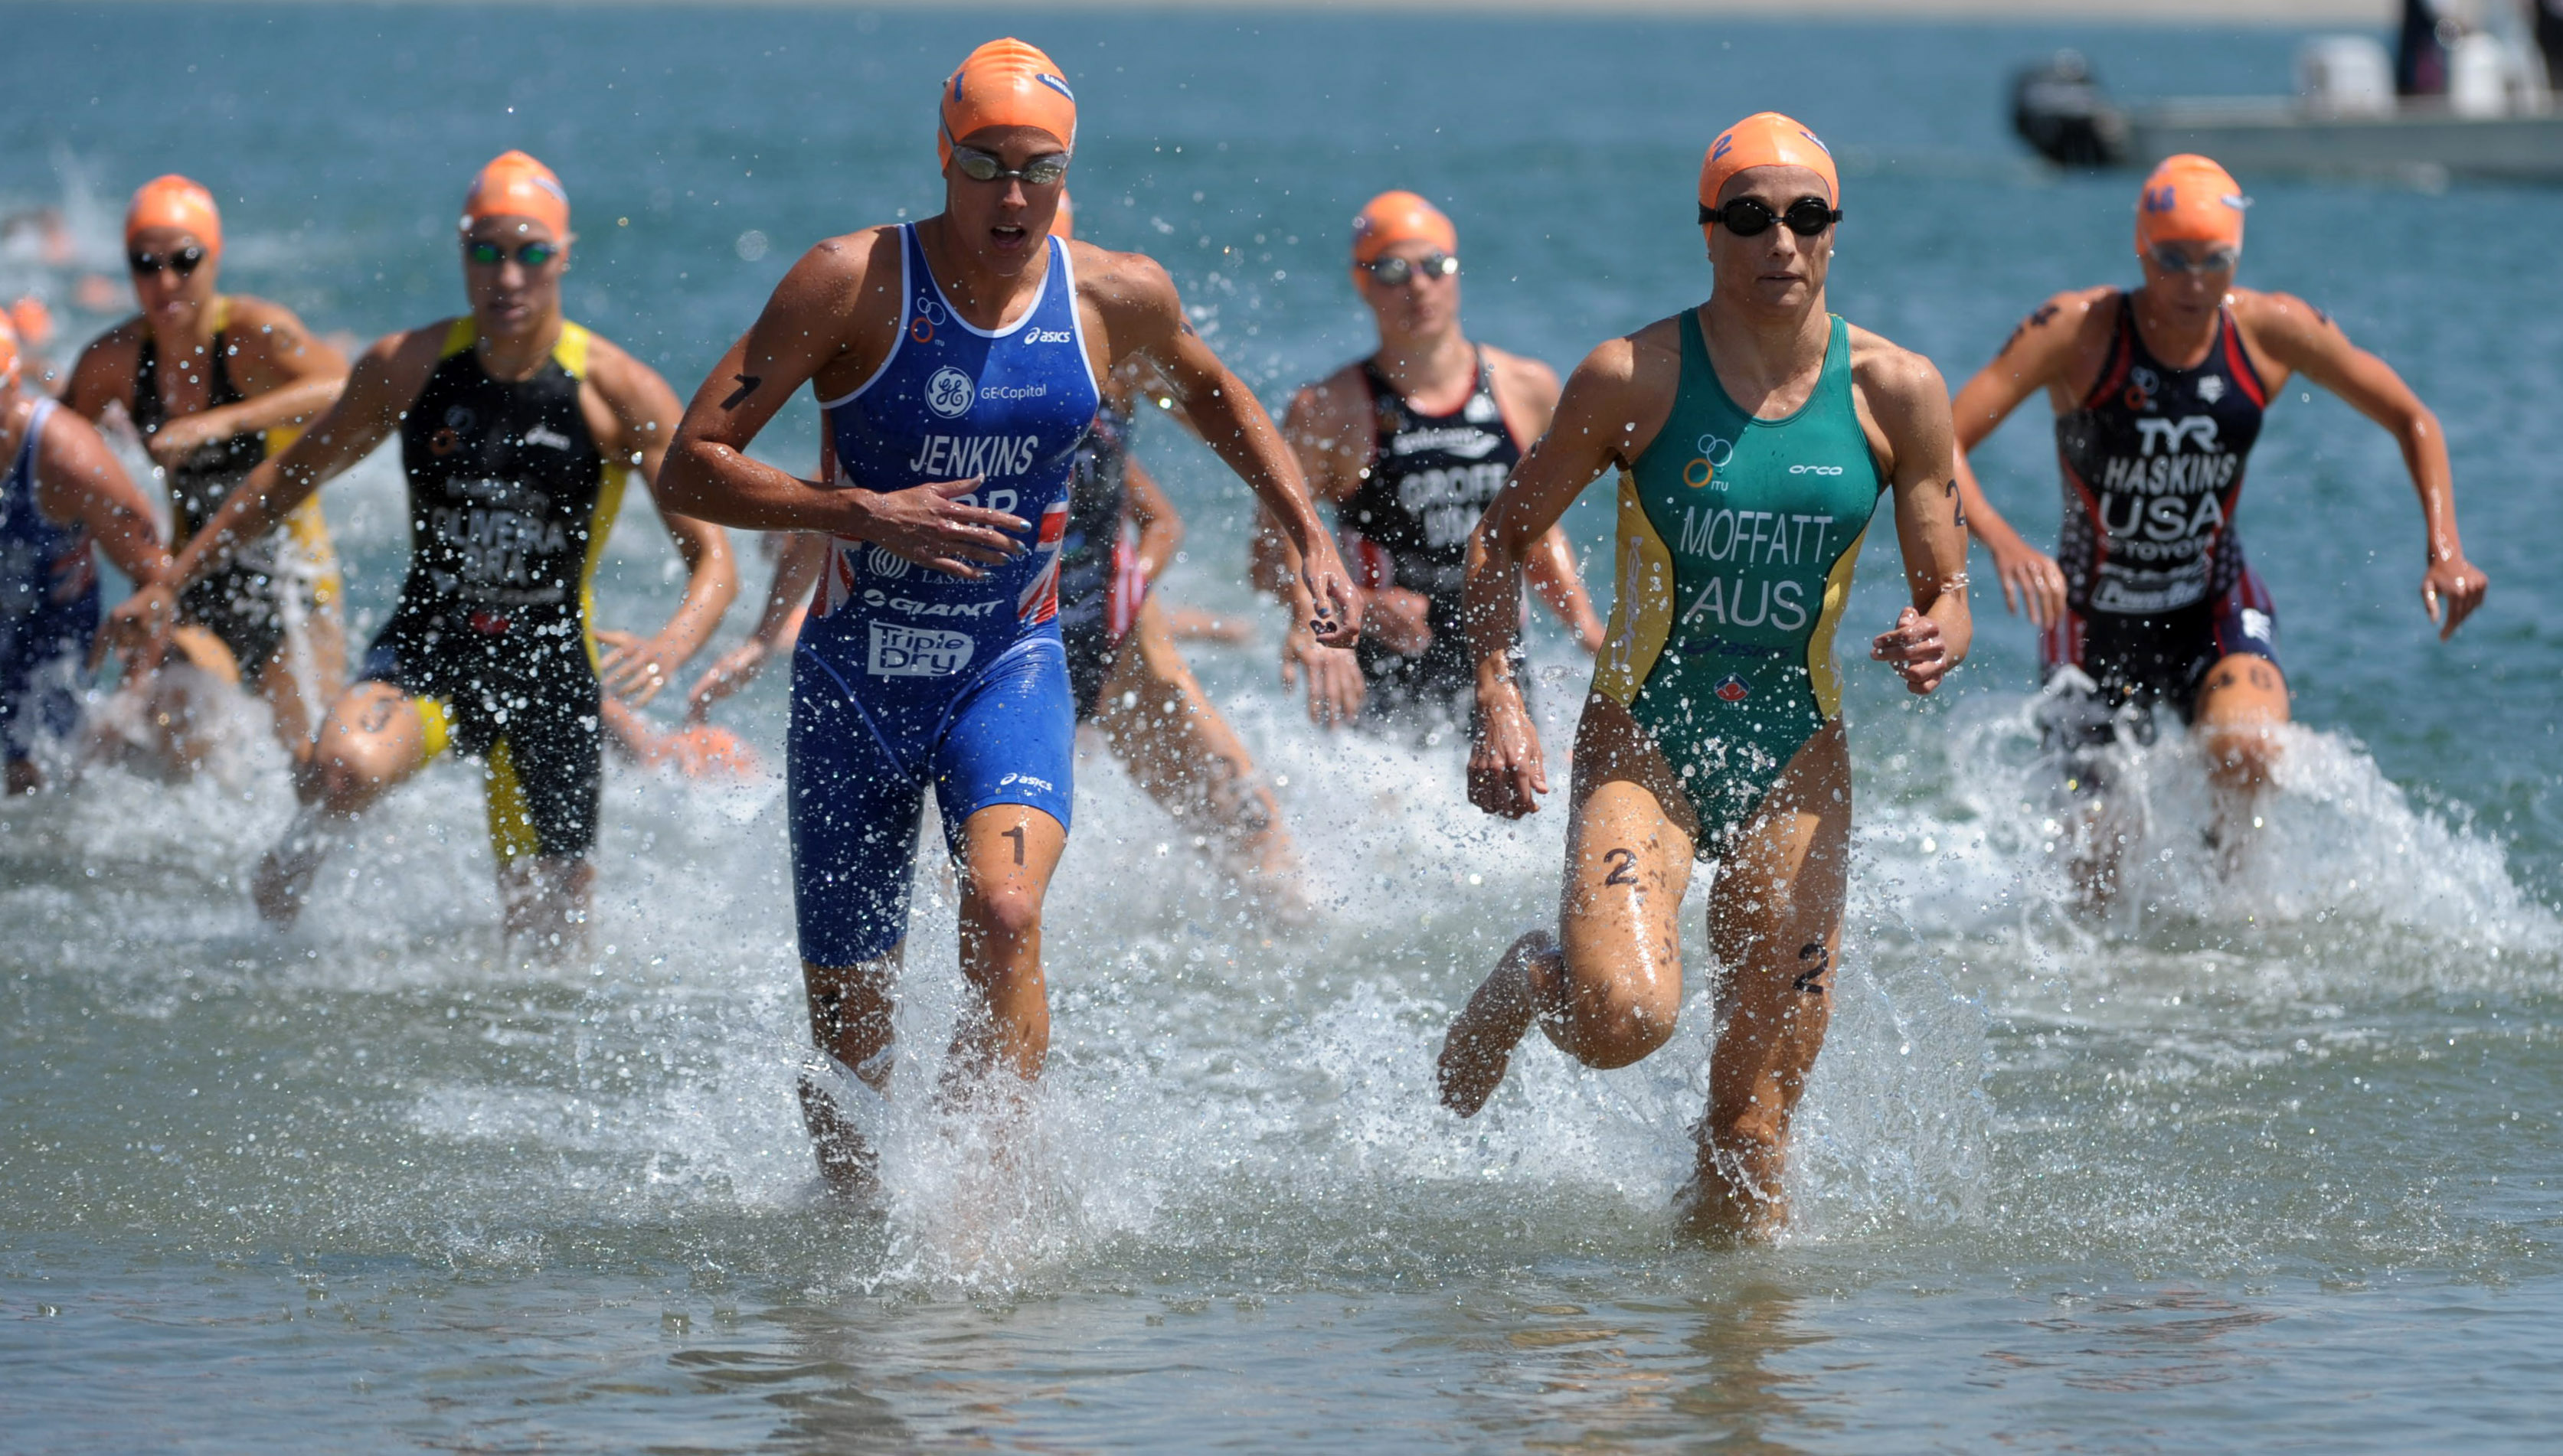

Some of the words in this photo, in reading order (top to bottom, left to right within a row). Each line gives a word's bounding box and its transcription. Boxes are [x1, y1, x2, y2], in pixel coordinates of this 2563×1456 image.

[1711, 134, 1733, 163] 2
[1039, 330, 1071, 344] asics
[980, 387, 998, 400] GE
[999, 384, 1047, 400] Capital
[909, 434, 1039, 478] JENKINS
[2135, 415, 2218, 457] TYR
[1711, 480, 1729, 491] ITU
[1789, 464, 1844, 476] orca
[2104, 452, 2238, 496] HASKINS
[1944, 478, 1967, 527] 2
[2098, 491, 2224, 541] USA
[1679, 505, 1834, 565] MOFFATT
[888, 597, 1005, 617] GIANT
[1682, 576, 1807, 631] AUS
[871, 623, 965, 654] Triple
[879, 647, 956, 674] Dry
[1018, 775, 1053, 792] asics
[1001, 825, 1025, 866] 1
[1603, 847, 1639, 887] 2
[1792, 942, 1829, 994] 2
